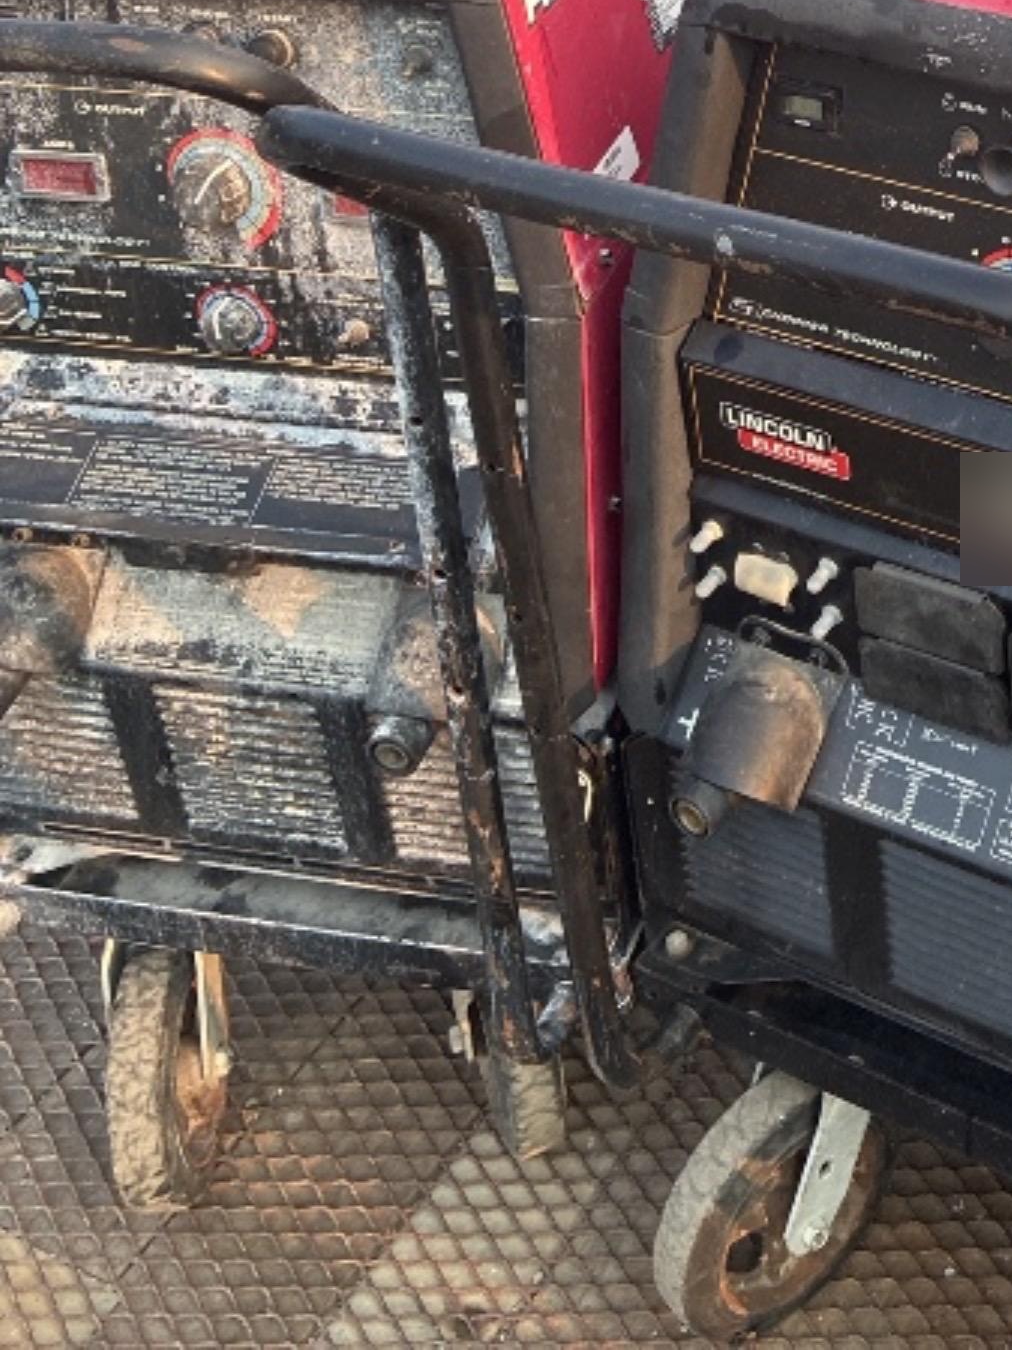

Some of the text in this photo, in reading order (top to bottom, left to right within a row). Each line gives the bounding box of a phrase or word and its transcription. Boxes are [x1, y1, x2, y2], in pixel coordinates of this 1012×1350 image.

[901, 200, 955, 223] OUTPUT
[727, 407, 824, 451] LINCOLN
[751, 436, 838, 473] ELECTRIC
